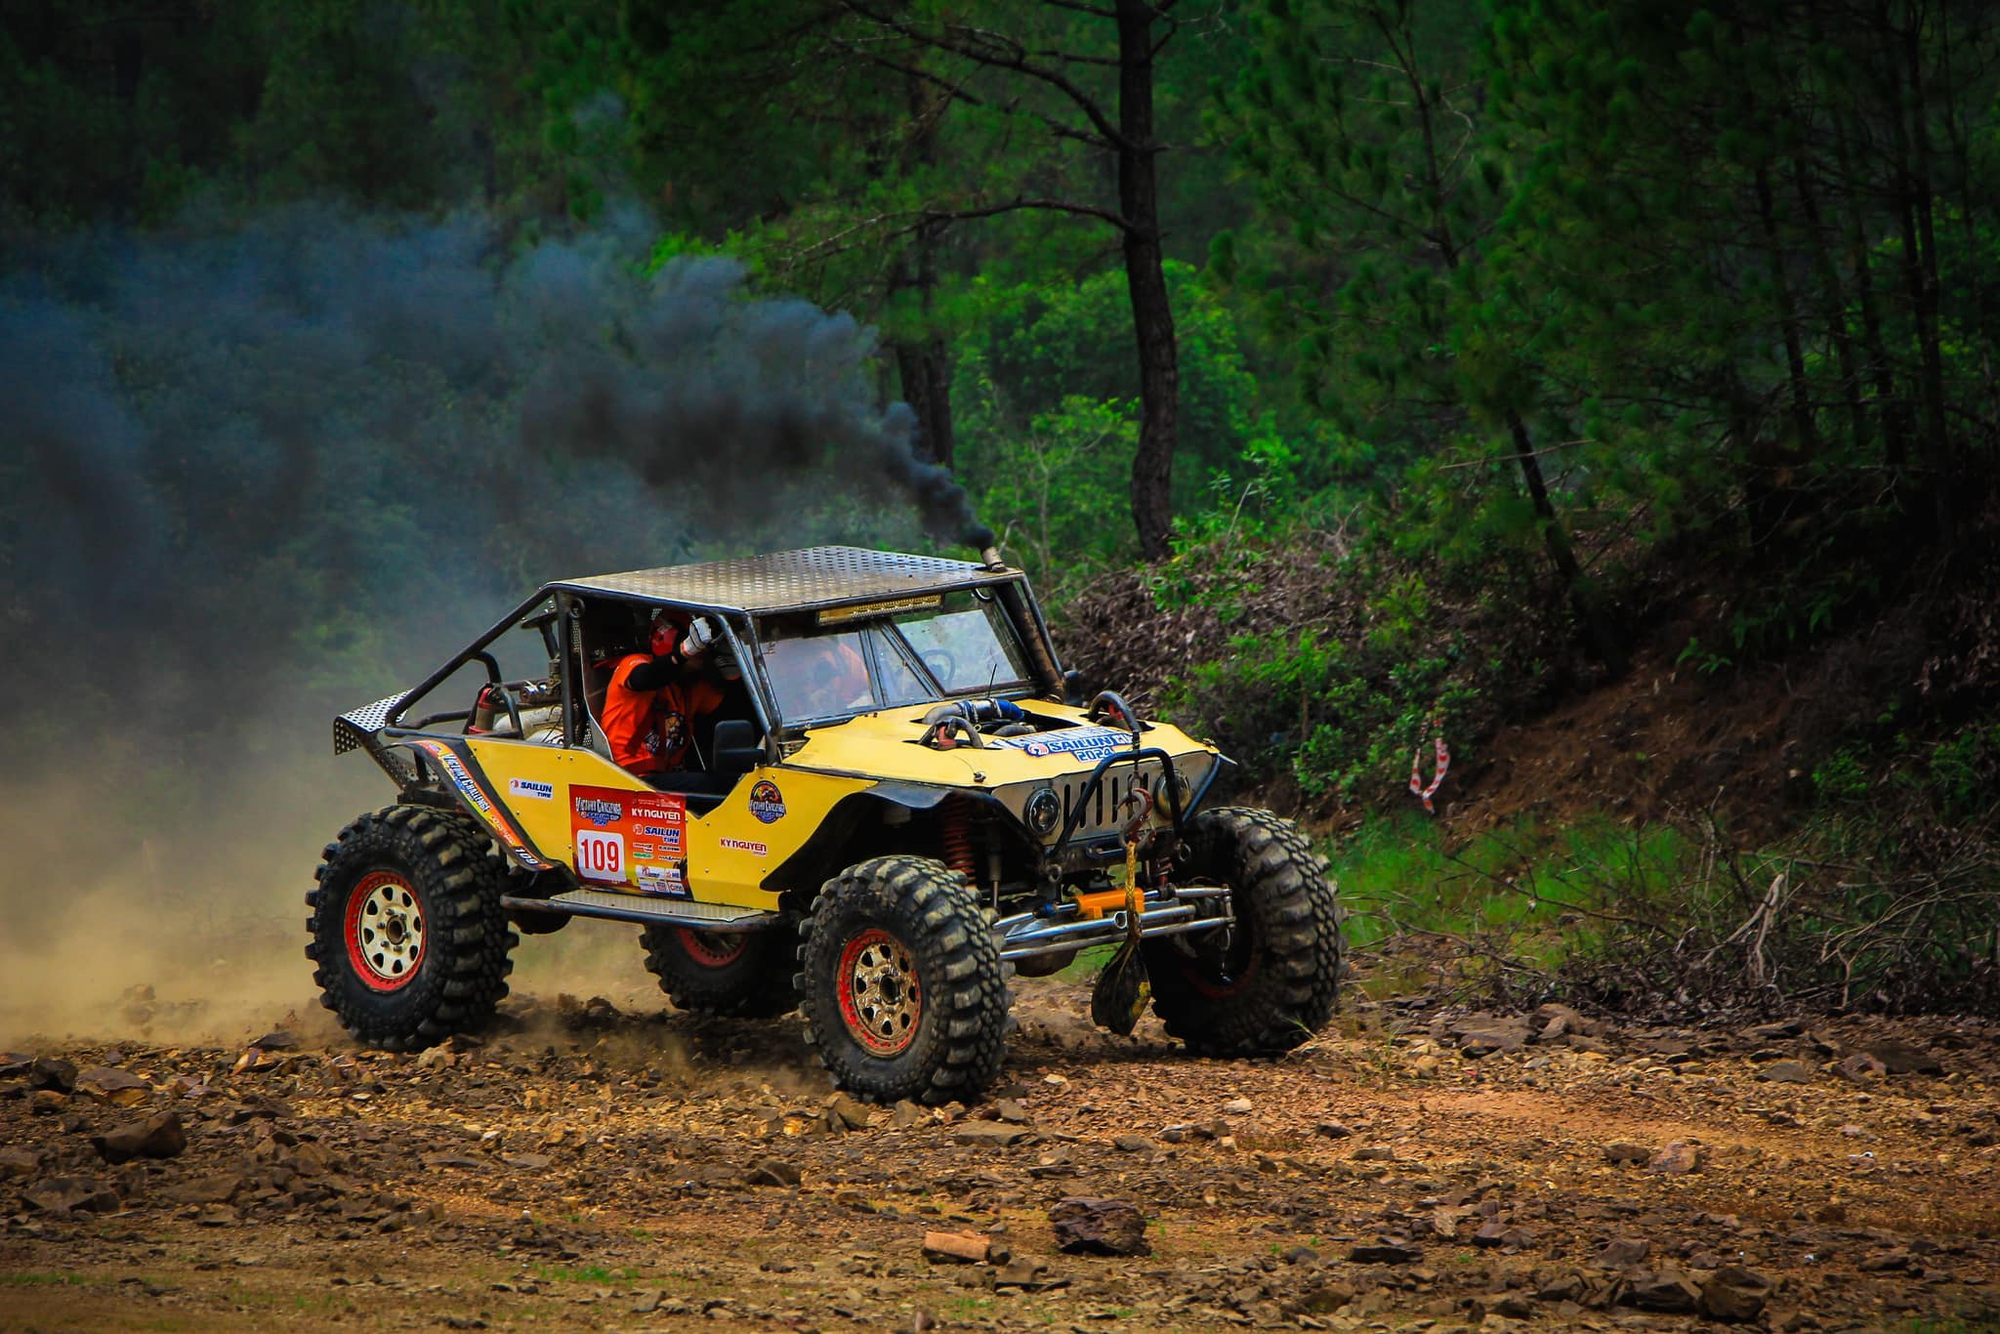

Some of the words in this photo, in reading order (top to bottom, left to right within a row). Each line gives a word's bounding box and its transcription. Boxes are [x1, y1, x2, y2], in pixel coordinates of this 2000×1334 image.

[1050, 736, 1112, 752] SAILUN
[1077, 747, 1114, 763] 2024
[520, 781, 552, 792] SAILUN
[644, 826, 680, 837] SAILUN
[515, 848, 539, 866] 109
[581, 839, 620, 873] 109
